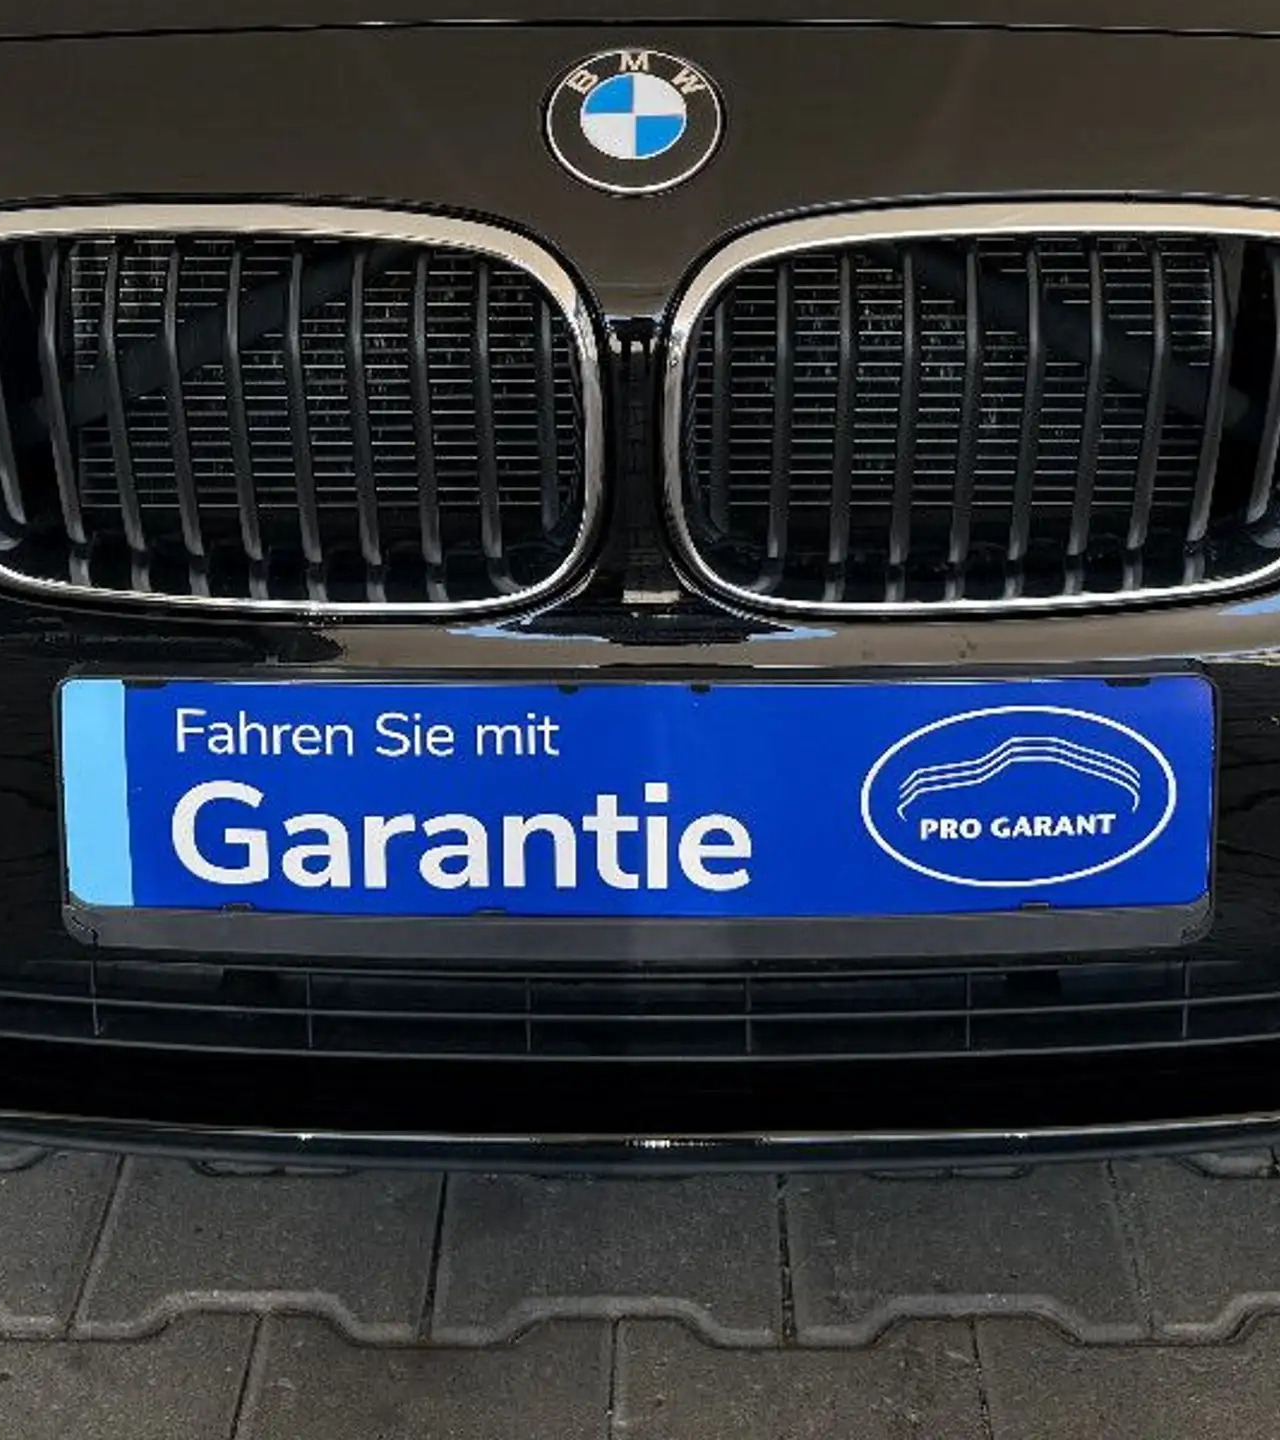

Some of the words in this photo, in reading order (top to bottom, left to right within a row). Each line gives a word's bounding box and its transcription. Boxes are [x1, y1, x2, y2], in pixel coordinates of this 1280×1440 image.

[565, 51, 708, 95] BMW
[175, 707, 353, 756] Fahren
[375, 712, 455, 757] Sie
[476, 713, 560, 756] mit
[171, 779, 752, 891] Garantie
[920, 817, 983, 841] PRO
[990, 813, 1117, 839] GARANT
